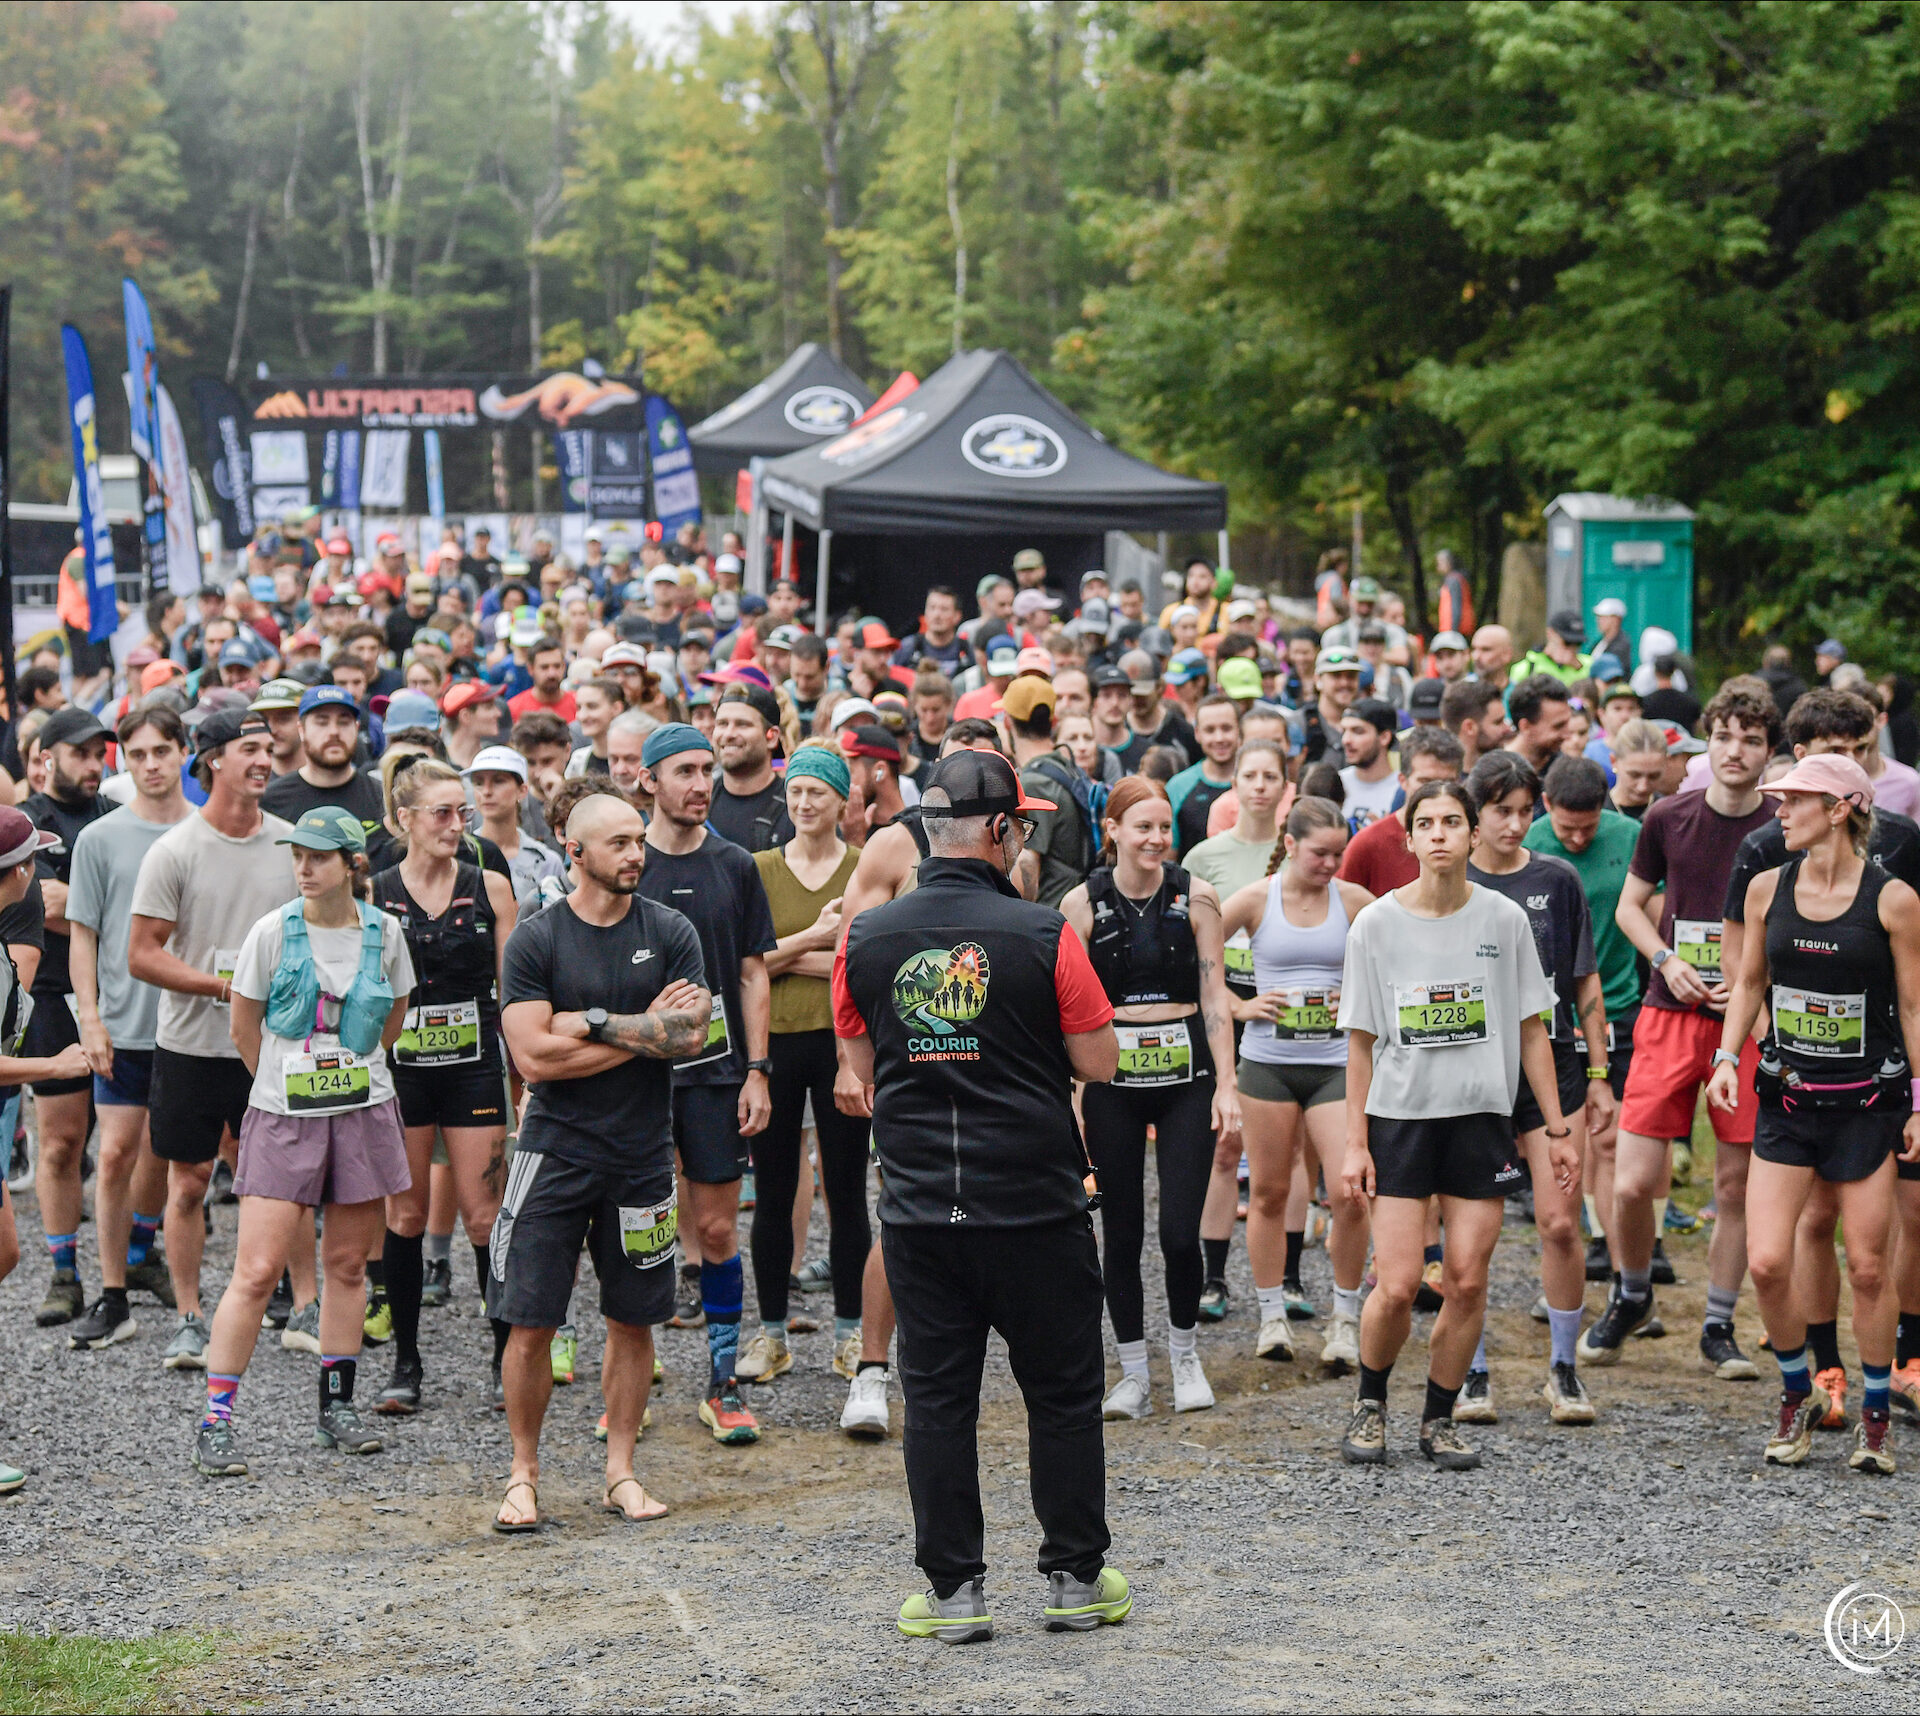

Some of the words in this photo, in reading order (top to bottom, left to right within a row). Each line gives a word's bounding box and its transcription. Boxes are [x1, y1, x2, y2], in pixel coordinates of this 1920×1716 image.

[1793, 938, 1839, 951] TEQUILA
[1295, 1010, 1331, 1025] 1126
[1420, 1006, 1467, 1026] 1228
[1795, 1016, 1840, 1037] 1159
[416, 1030, 459, 1047] 1230
[907, 1037, 980, 1052] COURIR
[1409, 1035, 1450, 1044] Dominique
[1792, 1040, 1815, 1051] Sophie
[416, 1055, 437, 1064] Nancy
[909, 1052, 980, 1062] LAURENTIDES
[1129, 1051, 1172, 1067] 1214
[307, 1072, 352, 1092] 1244
[642, 1254, 660, 1265] Brice
